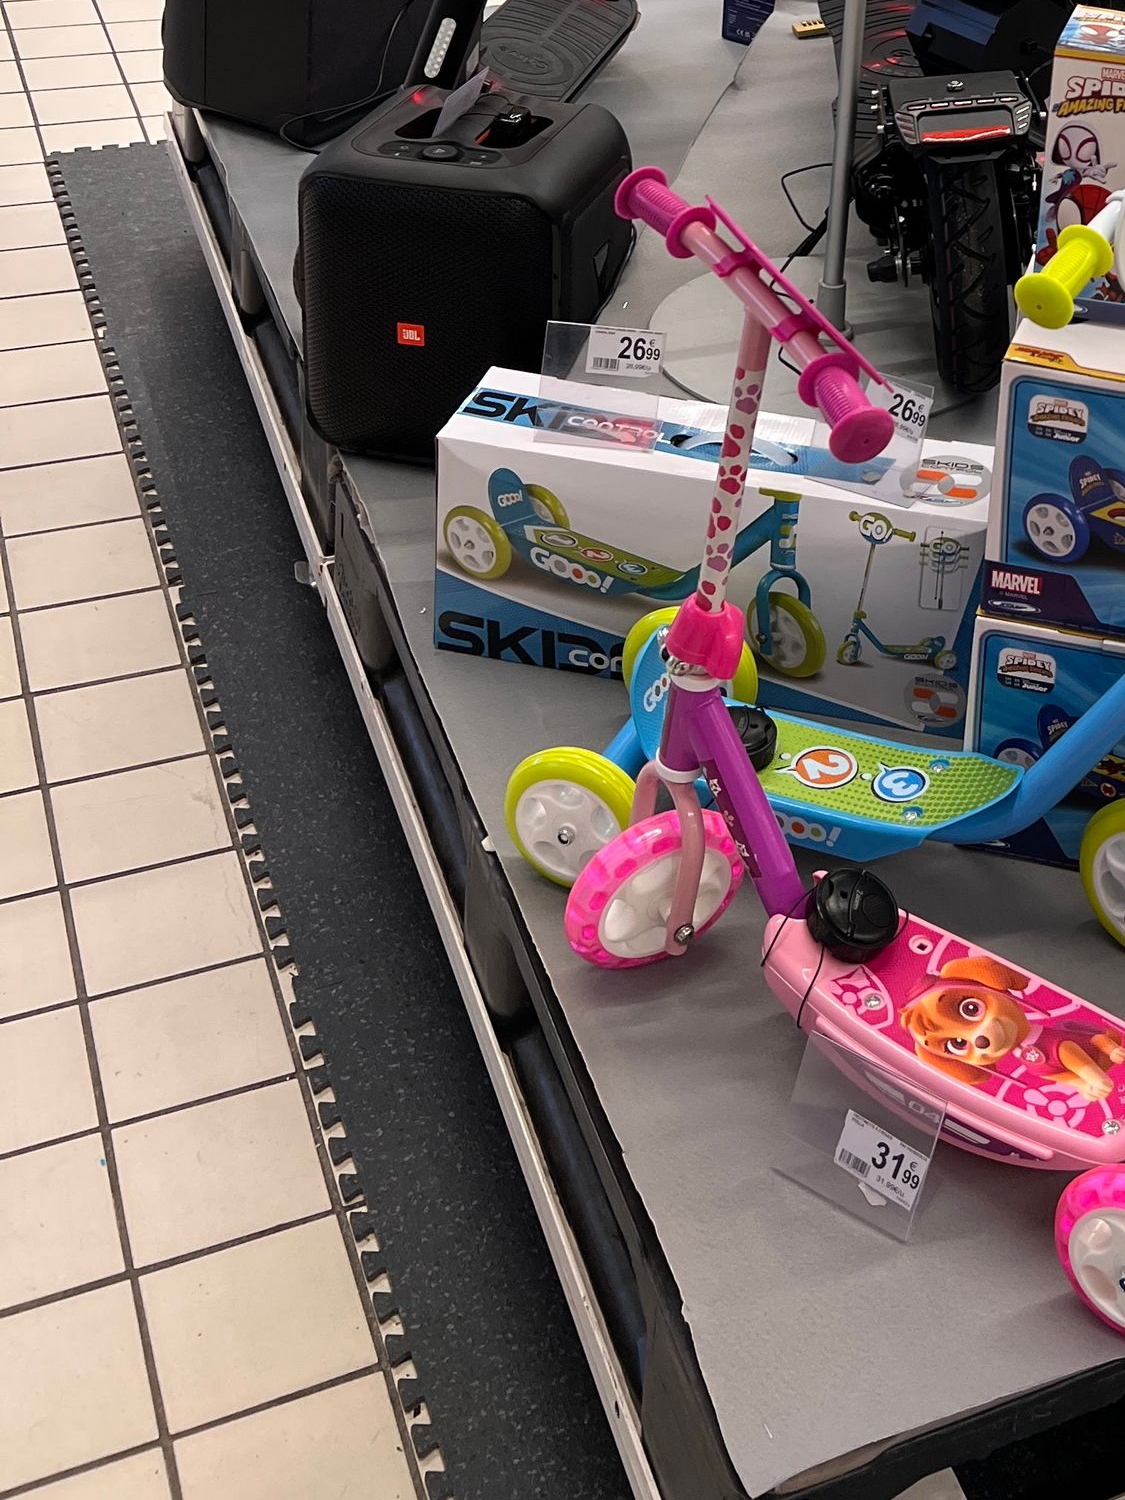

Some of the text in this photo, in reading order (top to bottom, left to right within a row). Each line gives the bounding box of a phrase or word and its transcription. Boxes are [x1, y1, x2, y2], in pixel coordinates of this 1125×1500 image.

[1056, 98, 1114, 119] AMAZING
[402, 329, 421, 342] JBL
[1037, 402, 1083, 419] SPIDEY
[1053, 432, 1080, 443] Junior
[921, 458, 985, 471] SKIDS
[860, 513, 894, 543] GO!
[991, 570, 1041, 595] MARVEL
[1005, 653, 1053, 672] SPIDEY
[1021, 682, 1049, 693] Junior
[802, 754, 851, 781] 2
[881, 770, 920, 800] 3
